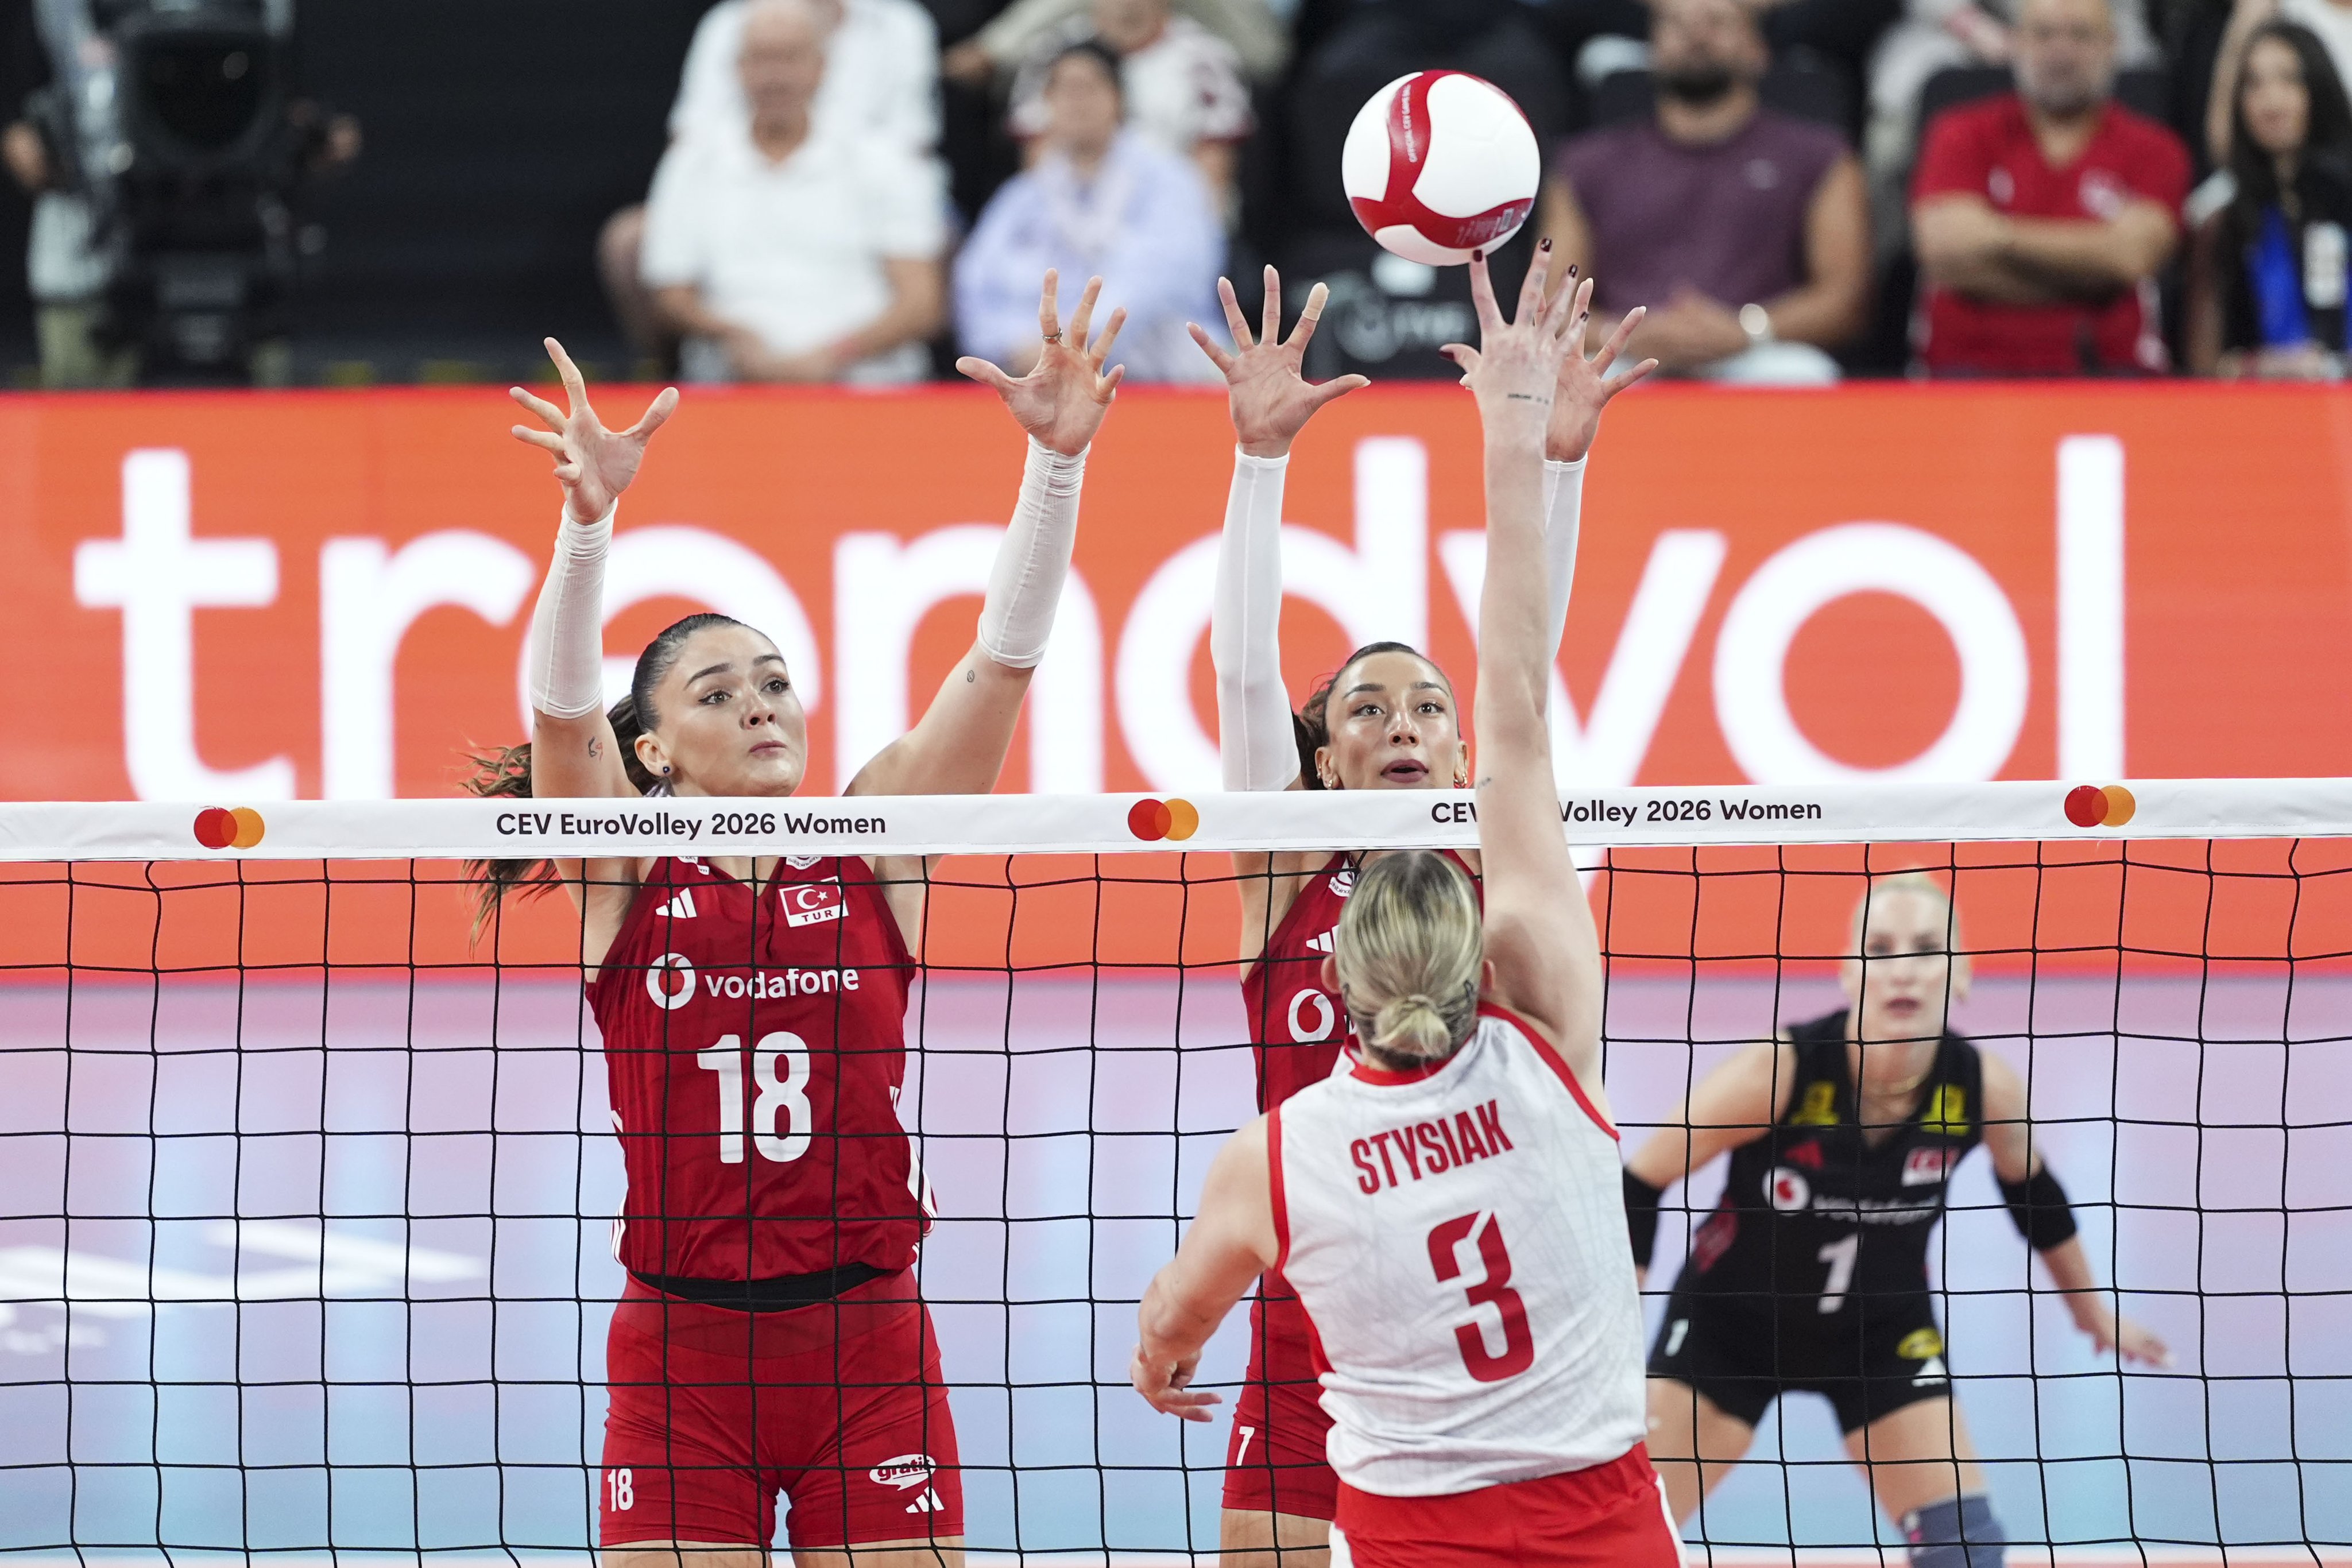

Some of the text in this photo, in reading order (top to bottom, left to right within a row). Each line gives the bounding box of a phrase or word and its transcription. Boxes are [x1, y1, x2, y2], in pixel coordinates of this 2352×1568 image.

[497, 812, 885, 841] CEV EuroVolley 2026 Women
[1558, 799, 1638, 827] Volley
[1647, 800, 1711, 822] 2026
[1719, 799, 1821, 820] Women
[802, 909, 833, 922] TUR
[704, 968, 860, 1000] vodafone
[696, 1031, 813, 1164] 18
[1351, 1099, 1515, 1195] STYSIAK
[1818, 1233, 1862, 1314] 1
[1428, 1211, 1535, 1383] 3
[1236, 1426, 1255, 1466] 7
[607, 1468, 633, 1512] 18
